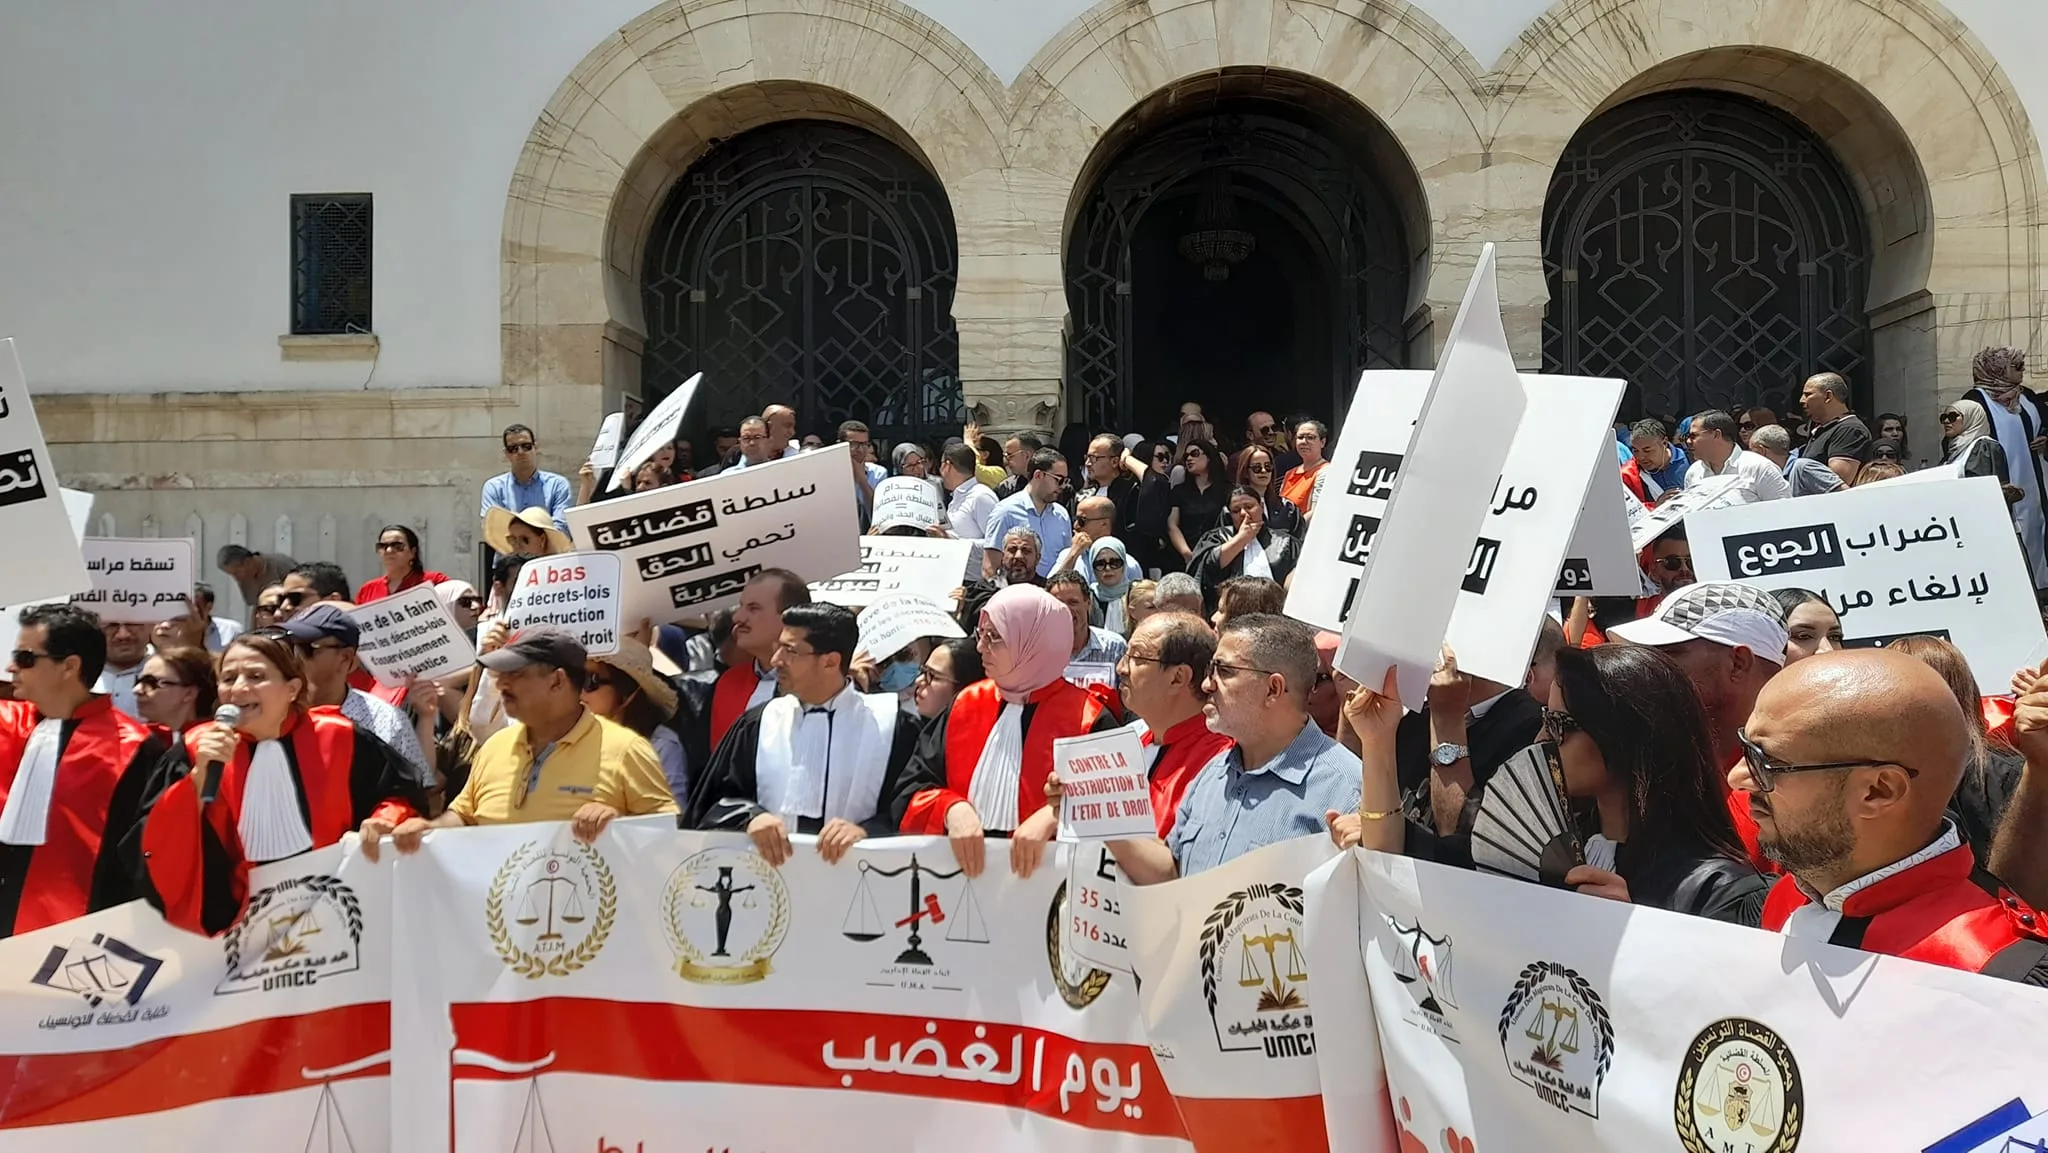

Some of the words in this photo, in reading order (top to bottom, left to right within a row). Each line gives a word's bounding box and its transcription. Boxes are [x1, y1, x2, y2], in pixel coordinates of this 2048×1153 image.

[722, 482, 817, 516] سلطة
[596, 504, 713, 549] قضائية
[1846, 516, 1965, 558] إضراب
[722, 522, 796, 563] تحمي
[1737, 529, 1834, 578] الجوع
[86, 557, 125, 576] مراس
[130, 557, 175, 571] تسقط
[641, 545, 712, 580] الحق
[526, 568, 540, 587] A
[547, 564, 587, 585] bas
[674, 568, 756, 603] لحرية
[111, 589, 148, 608] دولة
[510, 597, 523, 609] es
[526, 584, 611, 607] décrets-lois
[1888, 571, 1990, 607] لإلغاء
[374, 614, 391, 629] de
[388, 609, 405, 624] la
[404, 599, 438, 618] faim
[580, 628, 614, 646] droit
[407, 653, 449, 678] justice
[1068, 754, 1111, 775] CONTRE
[1111, 751, 1128, 768] LA
[1065, 775, 1135, 798] DESTRUCTION
[1136, 773, 1146, 790] D
[1071, 802, 1102, 821] L'ETAT
[1106, 801, 1121, 819] DE
[1080, 886, 1099, 908] 35
[1259, 908, 1272, 919] De
[1272, 909, 1283, 919] La
[1073, 916, 1100, 942] 516
[263, 970, 317, 992] UMCC
[1555, 984, 1564, 993] De
[1564, 988, 1572, 998] La
[1738, 1021, 1777, 1050] القضاة
[822, 1021, 1046, 1093] الغضب
[1060, 1052, 1144, 1119] يوم
[1533, 1080, 1570, 1114] UMCC
[1704, 1126, 1714, 1140] A
